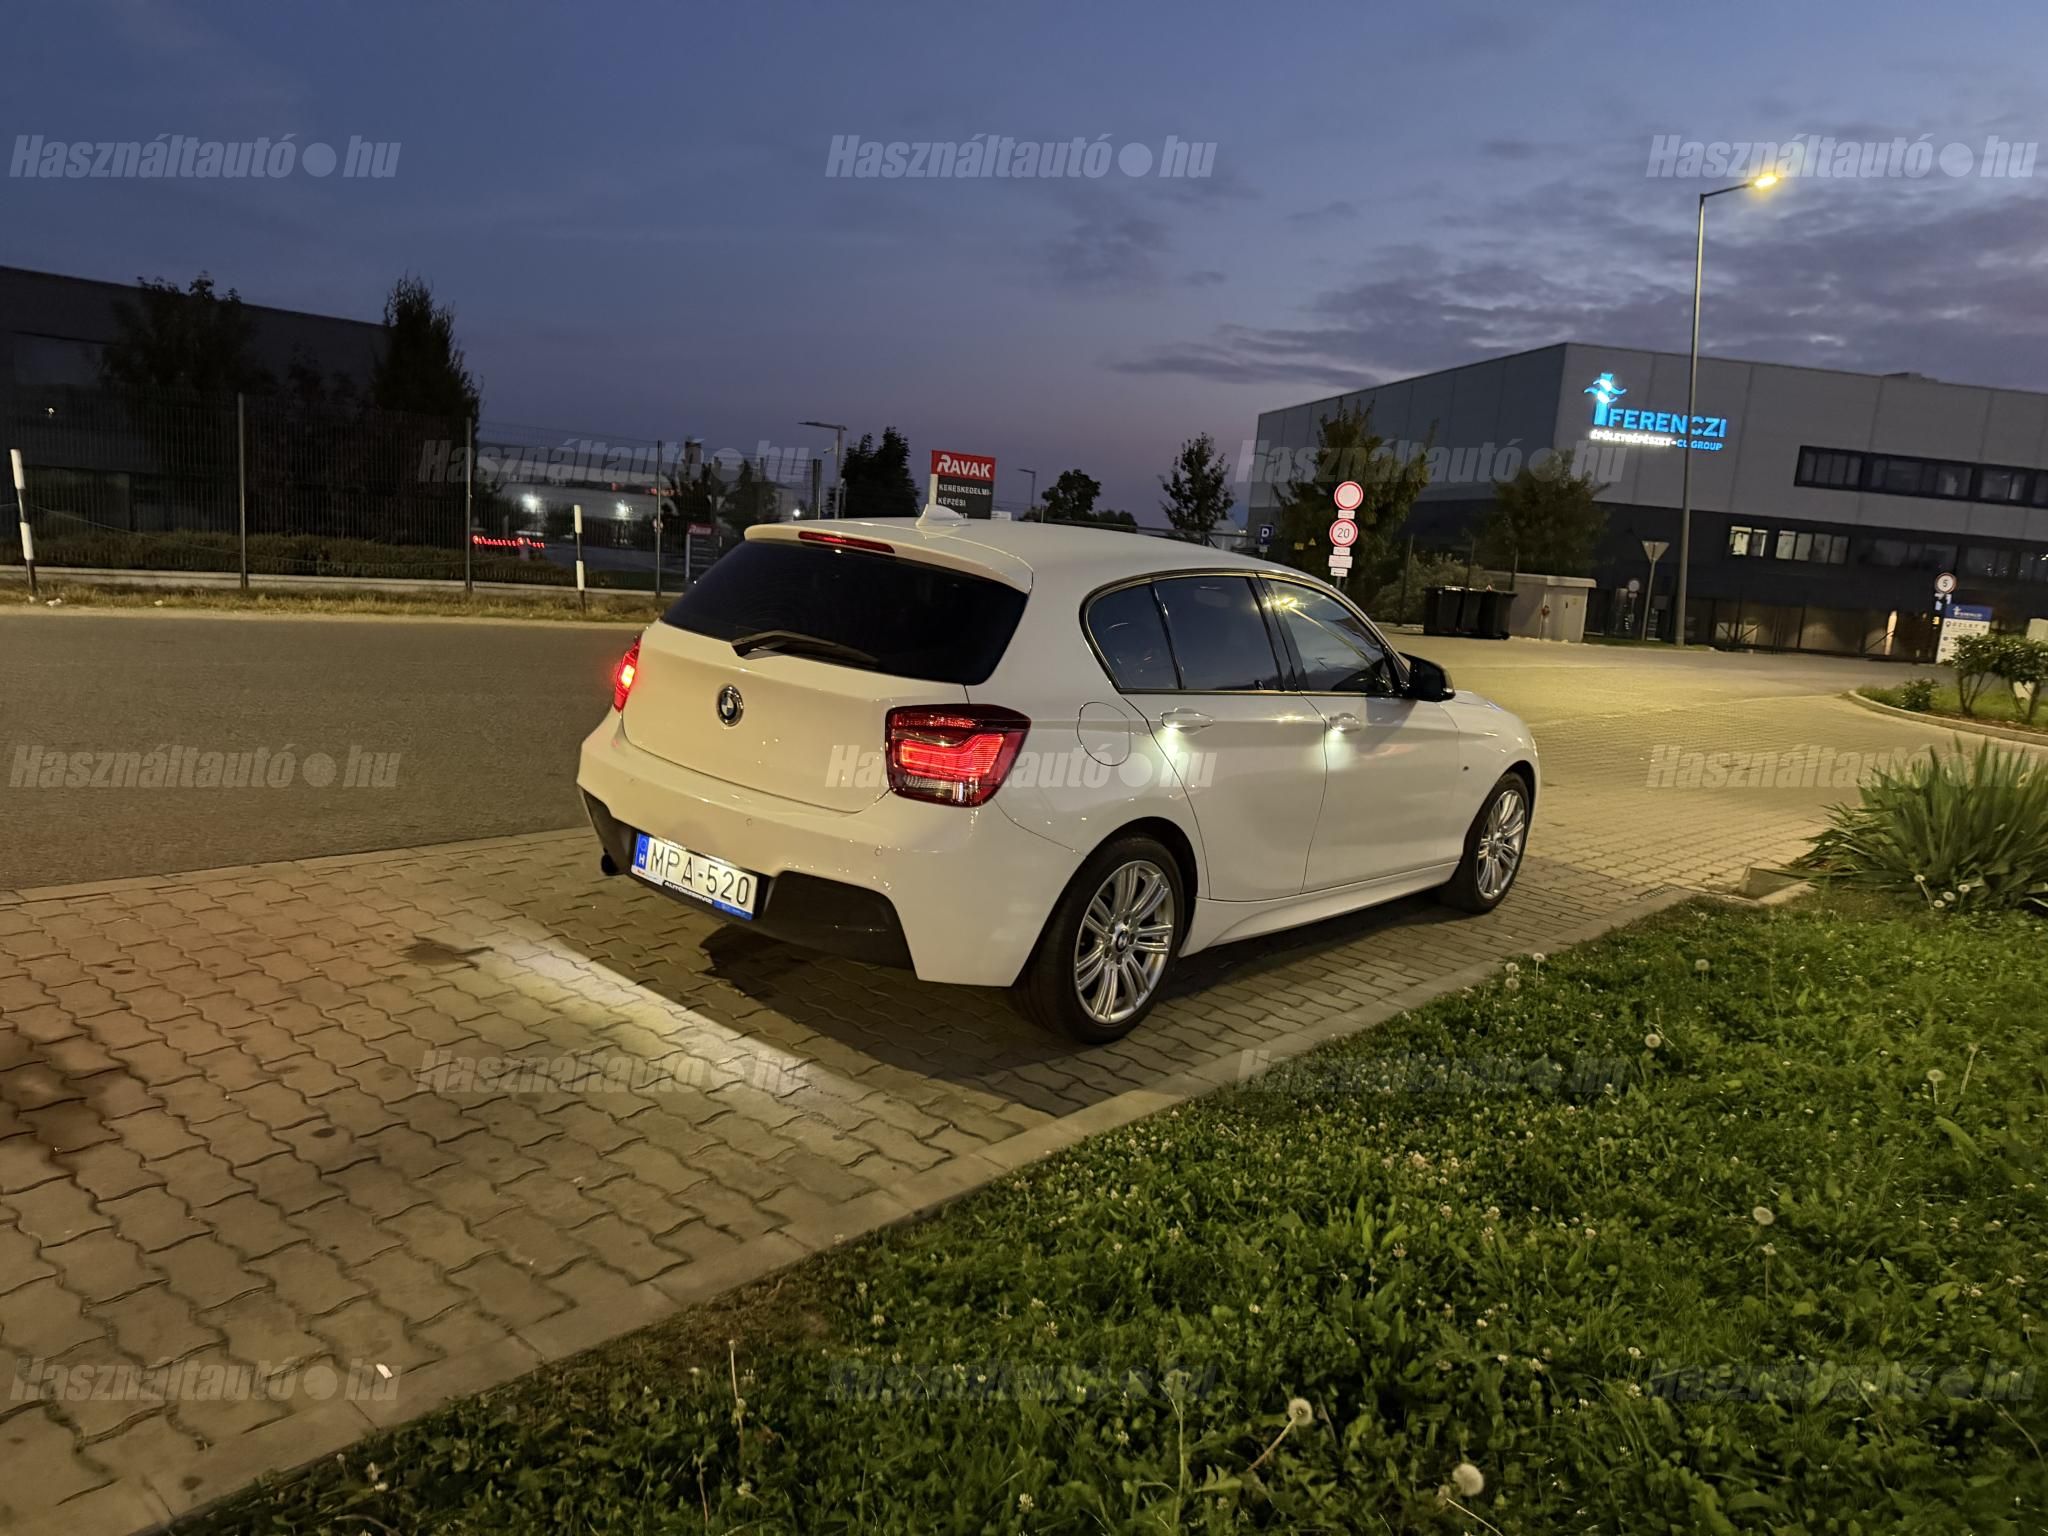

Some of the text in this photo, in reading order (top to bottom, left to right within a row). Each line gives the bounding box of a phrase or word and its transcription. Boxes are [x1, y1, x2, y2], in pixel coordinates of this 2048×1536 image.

[1609, 408, 1727, 438] FERENCZI
[1691, 440, 1723, 451] GROUP
[937, 454, 992, 478] RAVAK
[1337, 527, 1350, 539] 20
[638, 854, 646, 866] H
[651, 843, 750, 905] MPA-520
